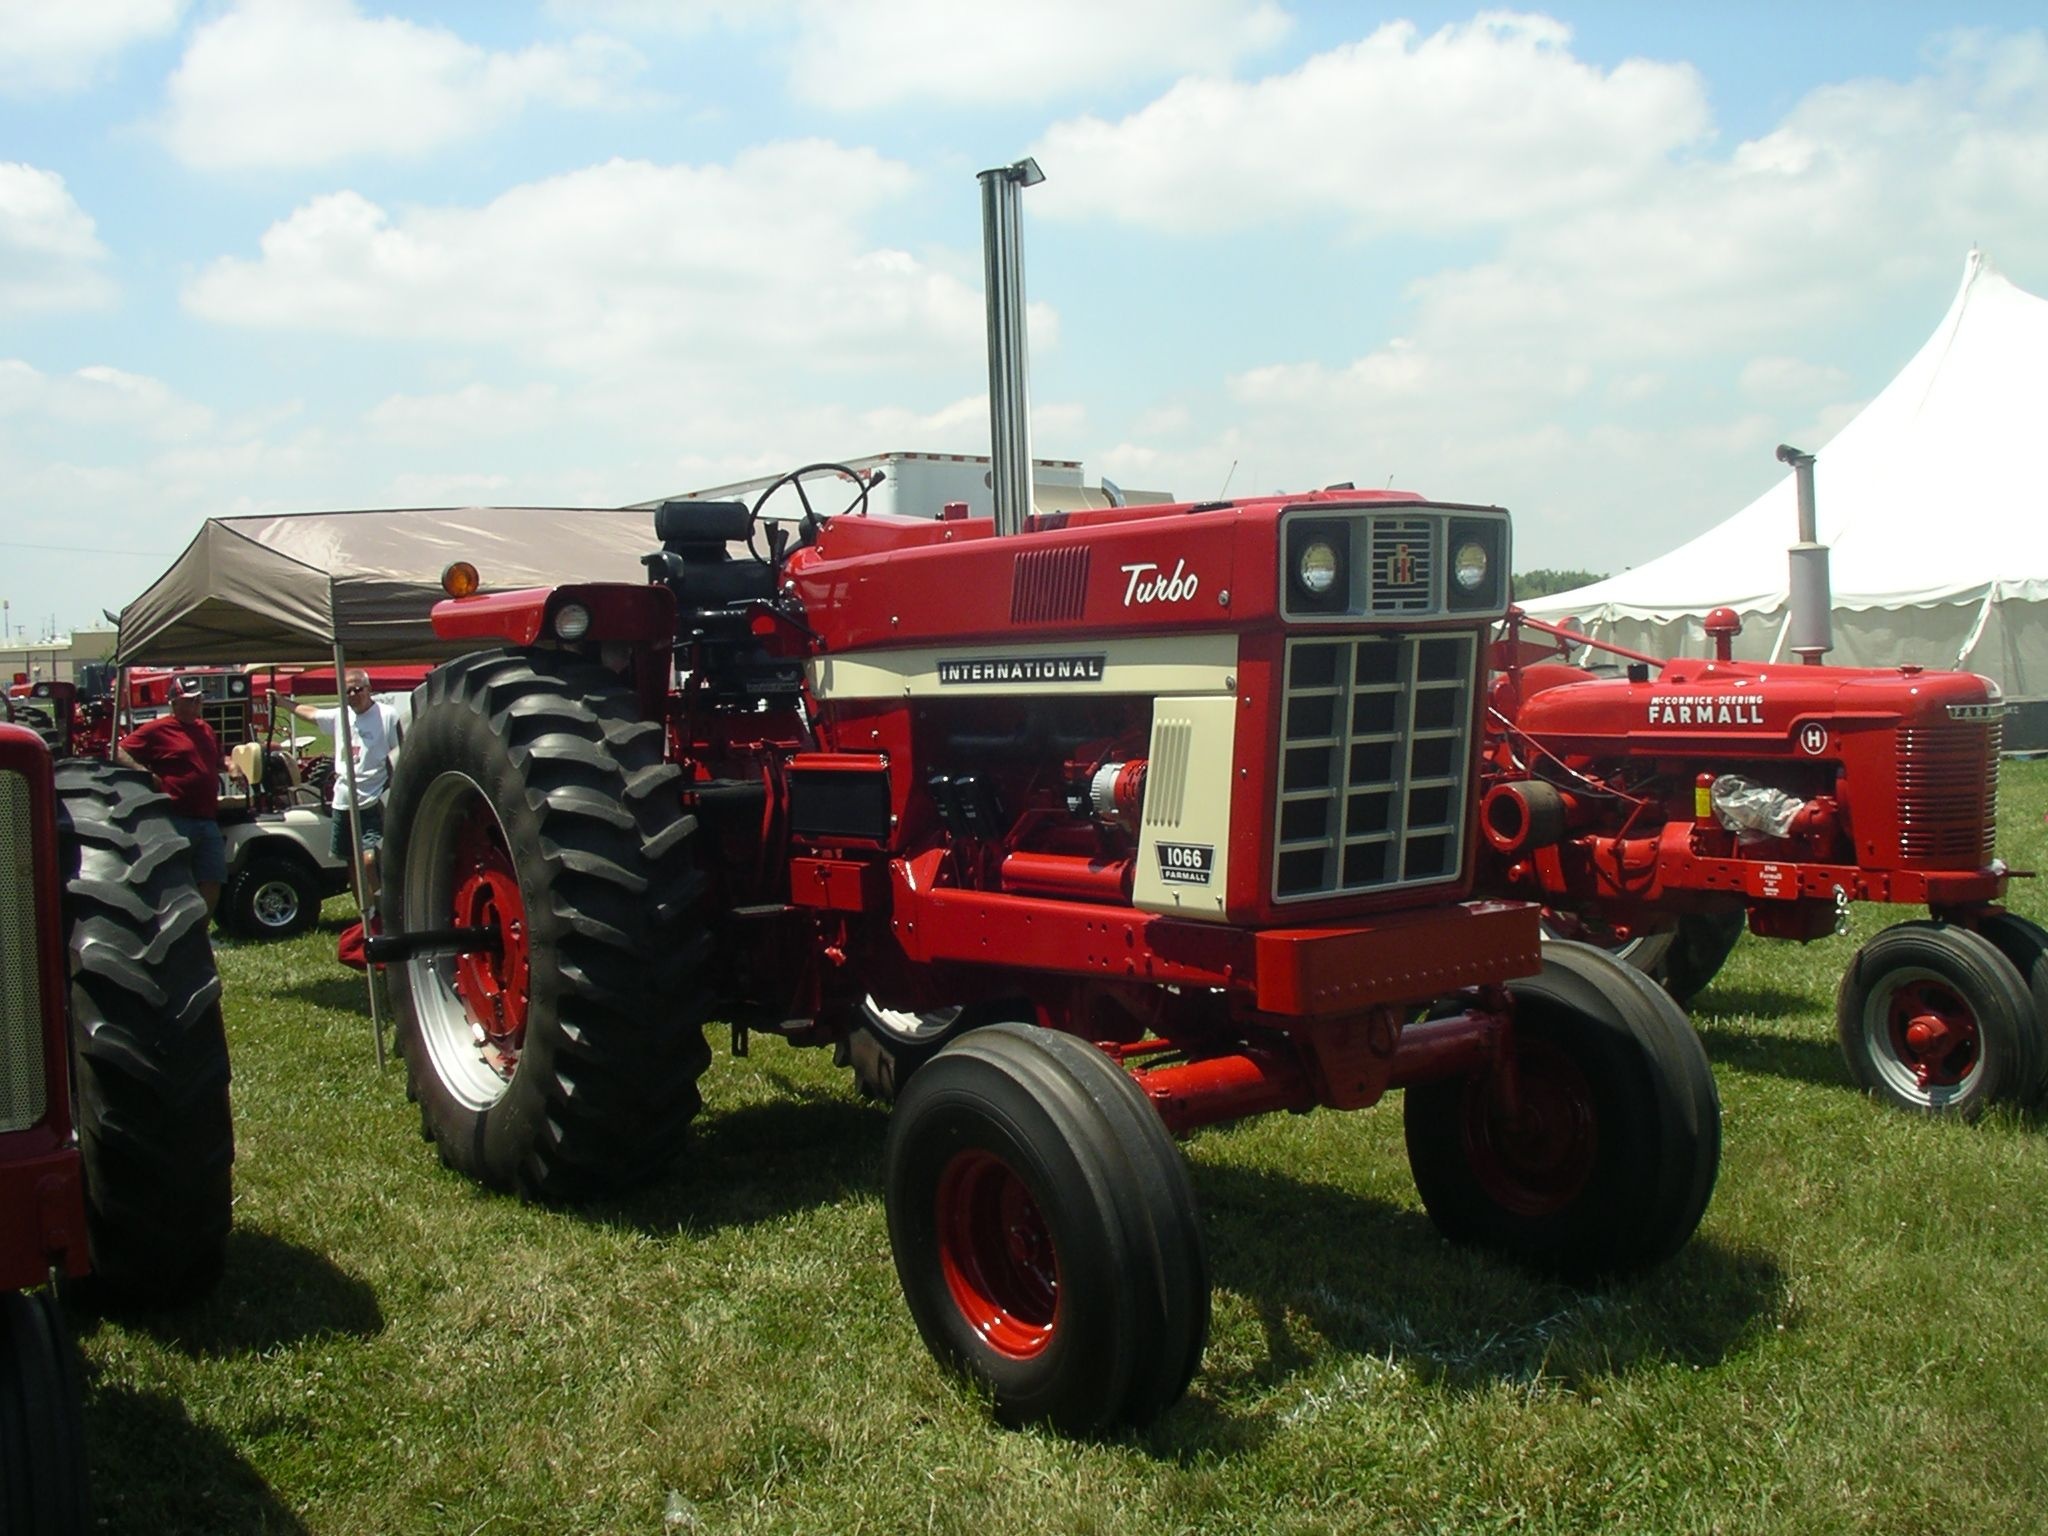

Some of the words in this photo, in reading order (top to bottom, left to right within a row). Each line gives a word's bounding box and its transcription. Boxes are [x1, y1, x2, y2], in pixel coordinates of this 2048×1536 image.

[1120, 558, 1199, 607] Turbo
[941, 660, 1100, 681] INTERNATIONAL
[1648, 705, 1765, 724] FARMALL
[1807, 730, 1821, 748] H
[1167, 847, 1202, 868] 1066
[1165, 870, 1206, 882] FARMALL
